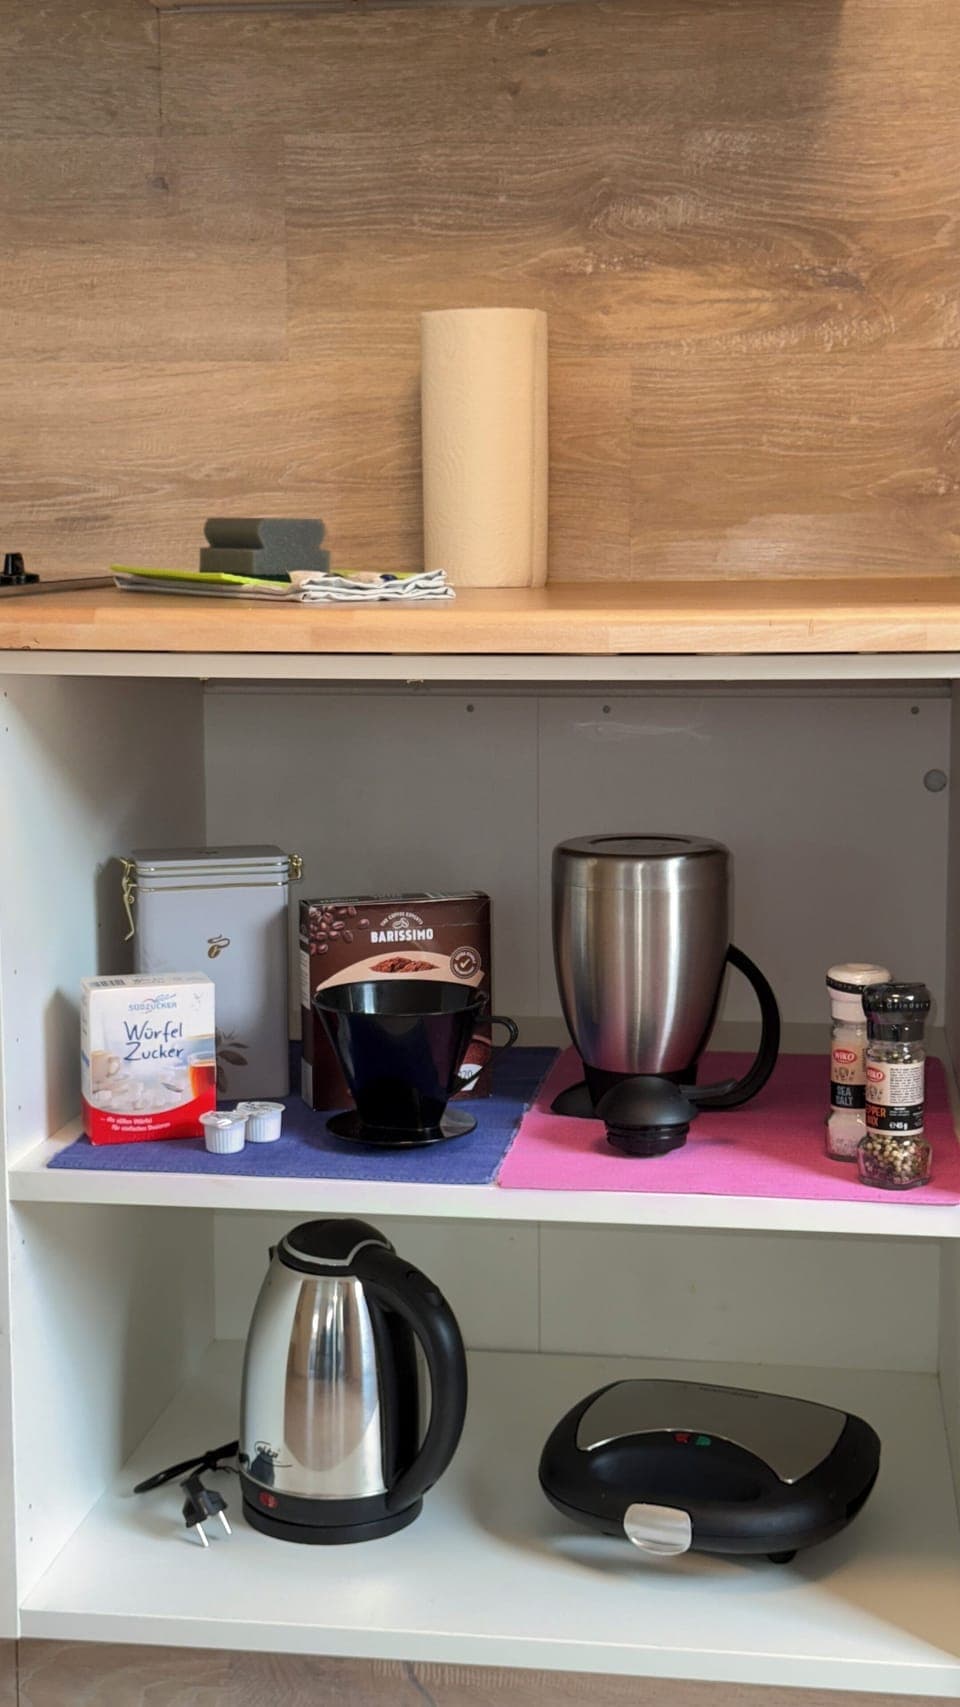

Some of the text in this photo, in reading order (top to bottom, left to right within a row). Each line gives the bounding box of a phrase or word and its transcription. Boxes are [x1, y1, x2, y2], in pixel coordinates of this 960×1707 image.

[370, 928, 434, 943] BARISSIMO
[123, 1020, 183, 1043] Würfel
[123, 1041, 185, 1061] Zucker
[836, 1085, 852, 1096] SEA
[835, 1096, 854, 1106] SALT
